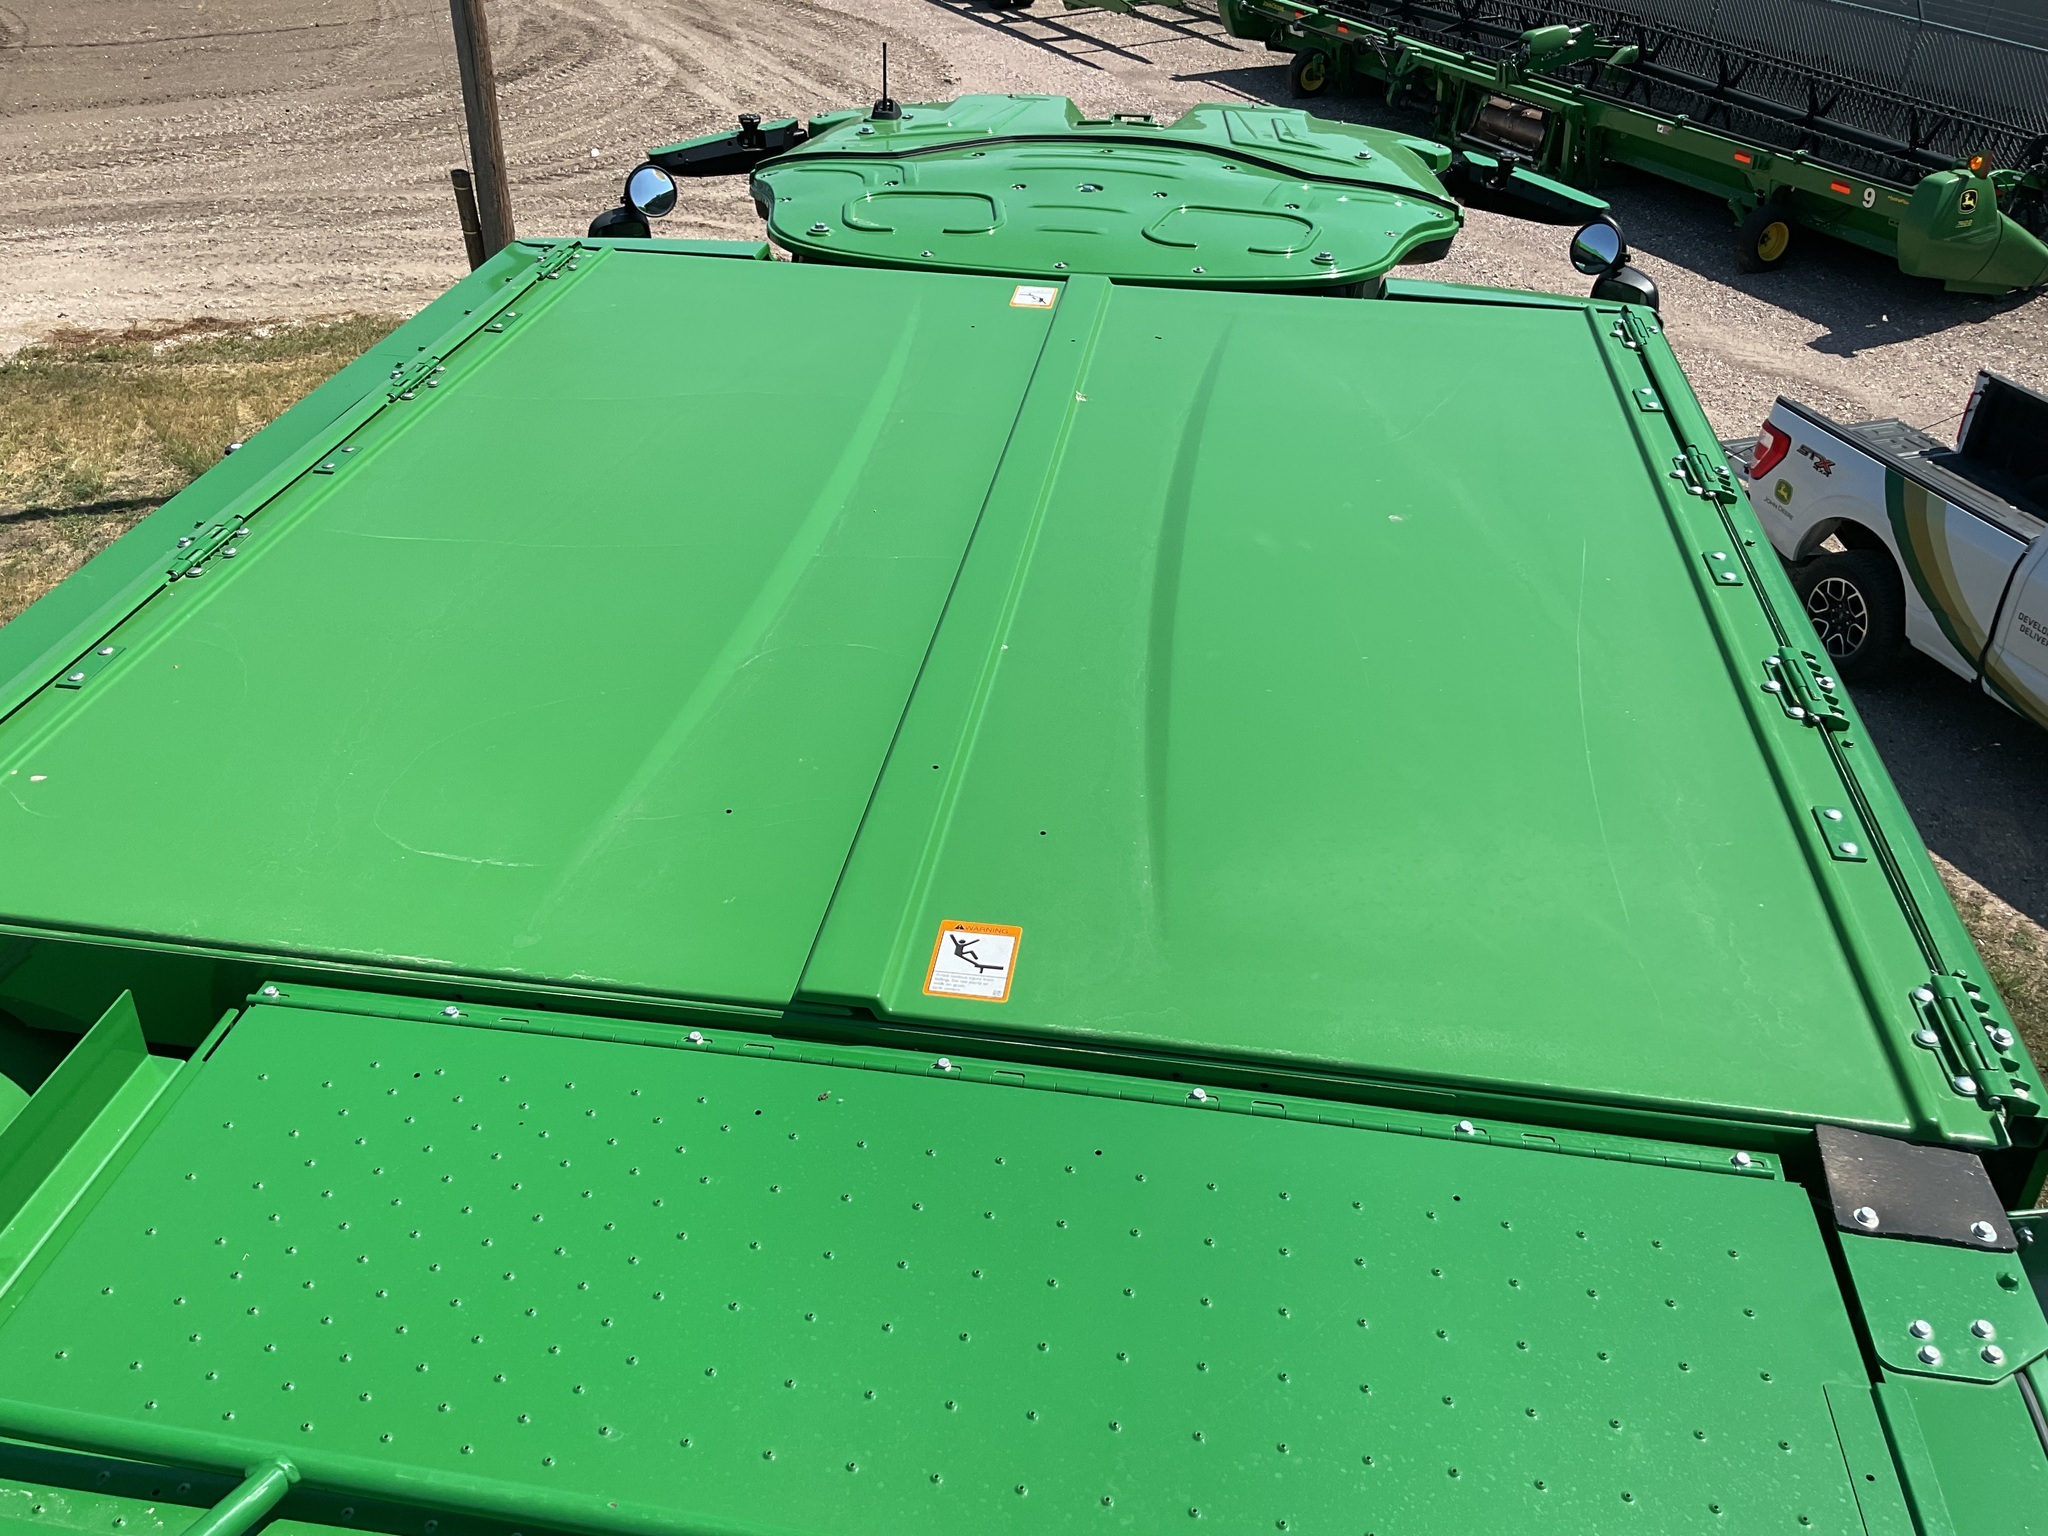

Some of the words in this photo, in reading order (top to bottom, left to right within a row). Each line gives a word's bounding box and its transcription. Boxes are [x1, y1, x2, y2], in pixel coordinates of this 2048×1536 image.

[1862, 187, 1876, 208] 9
[1797, 444, 1836, 475] STX
[2018, 612, 2048, 636] DEVELO
[965, 925, 1009, 935] WARNING
